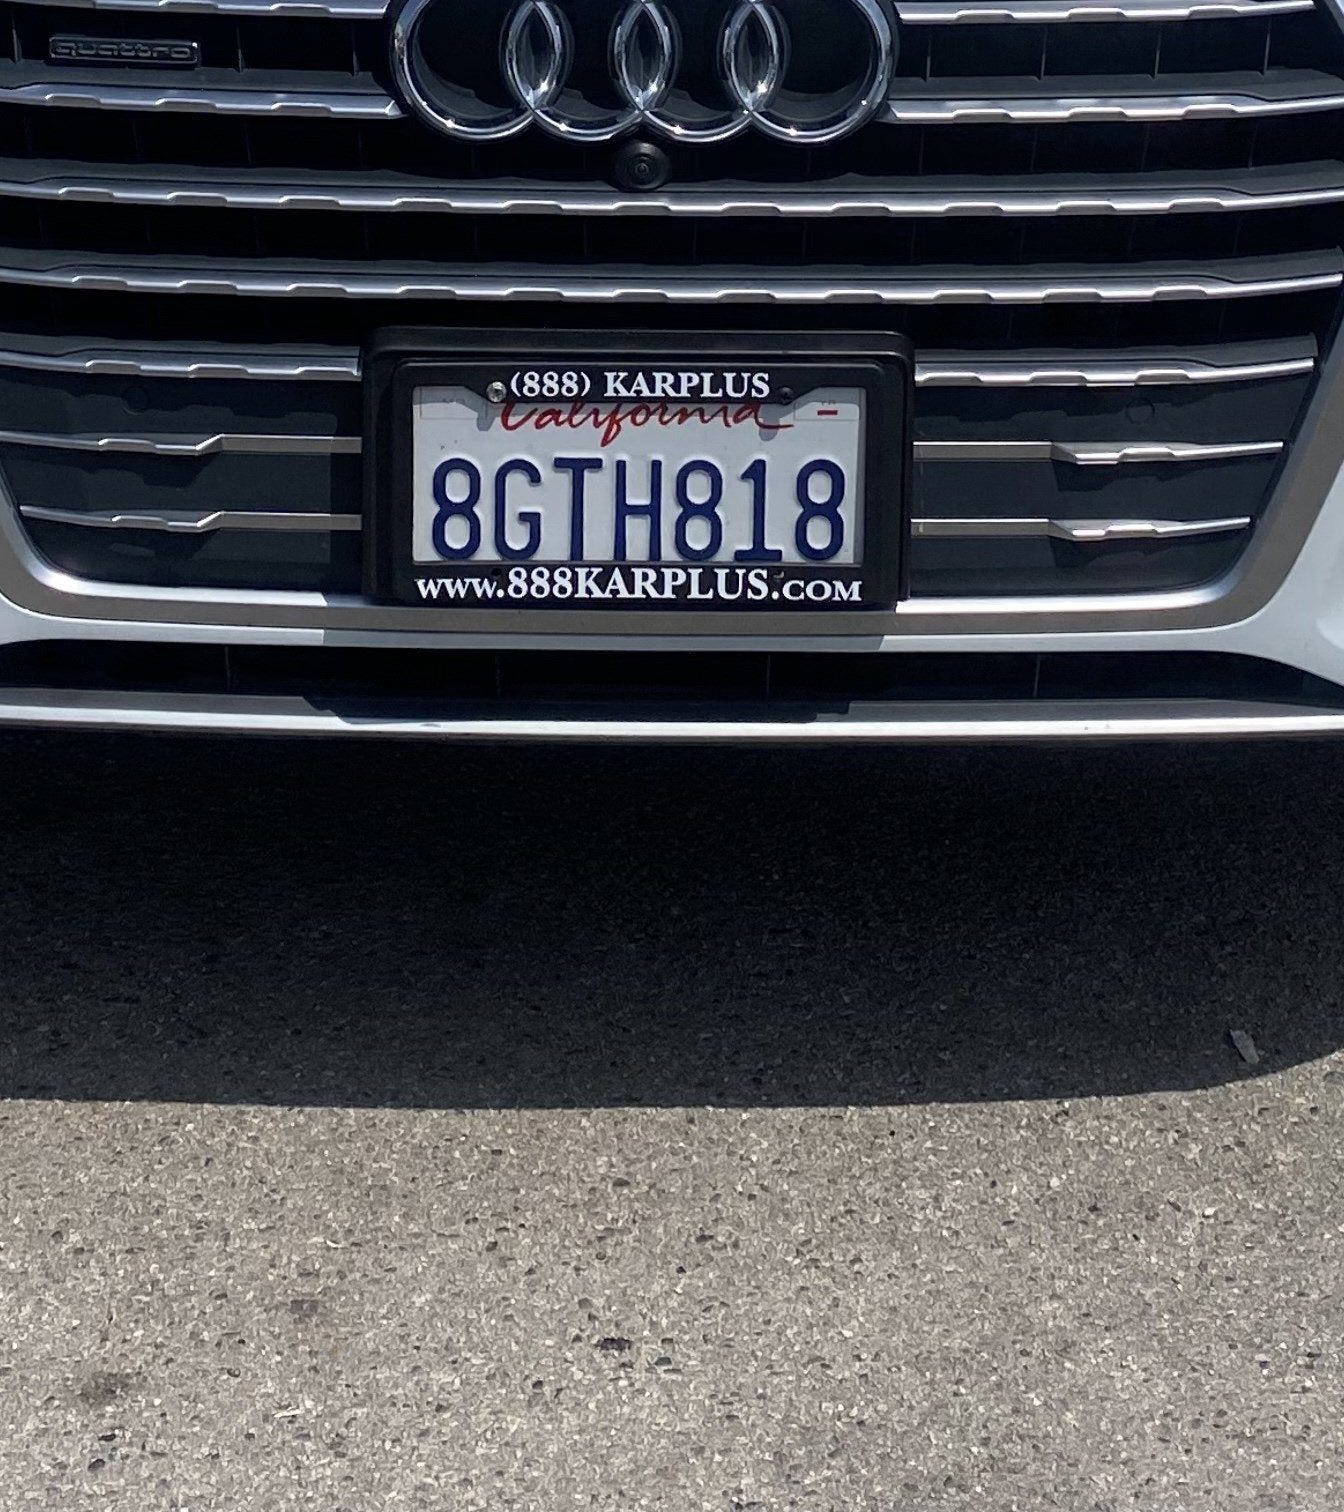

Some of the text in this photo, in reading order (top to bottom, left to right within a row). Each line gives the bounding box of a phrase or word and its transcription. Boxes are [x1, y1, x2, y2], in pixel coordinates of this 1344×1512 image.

[56, 41, 191, 59] quattro
[510, 371, 771, 398] (888) KARPLUS
[500, 400, 794, 447] California
[432, 457, 846, 562] 8GTH818
